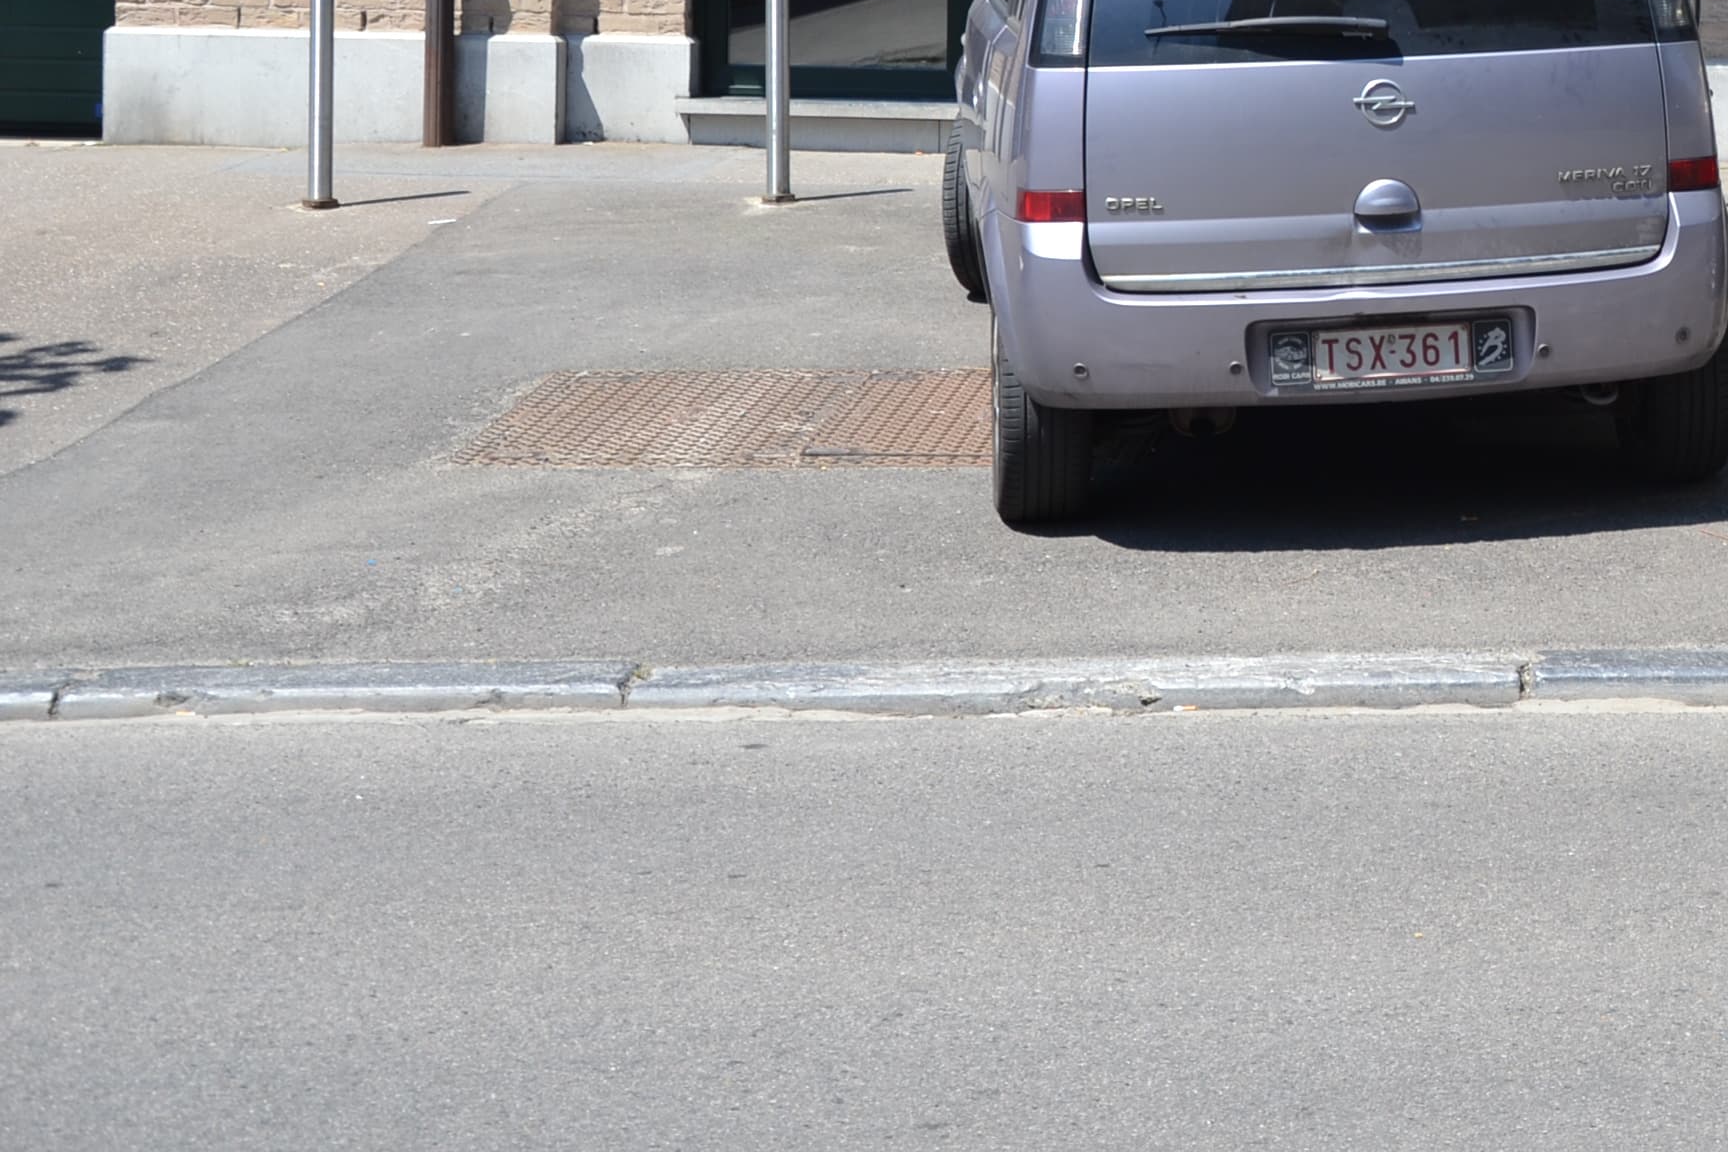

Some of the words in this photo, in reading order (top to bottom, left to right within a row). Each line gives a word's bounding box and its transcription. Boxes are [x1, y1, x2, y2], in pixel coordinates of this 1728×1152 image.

[1557, 167, 1626, 182] MERIVA
[1104, 195, 1164, 211] OPEL
[1320, 329, 1461, 375] TSX-361
